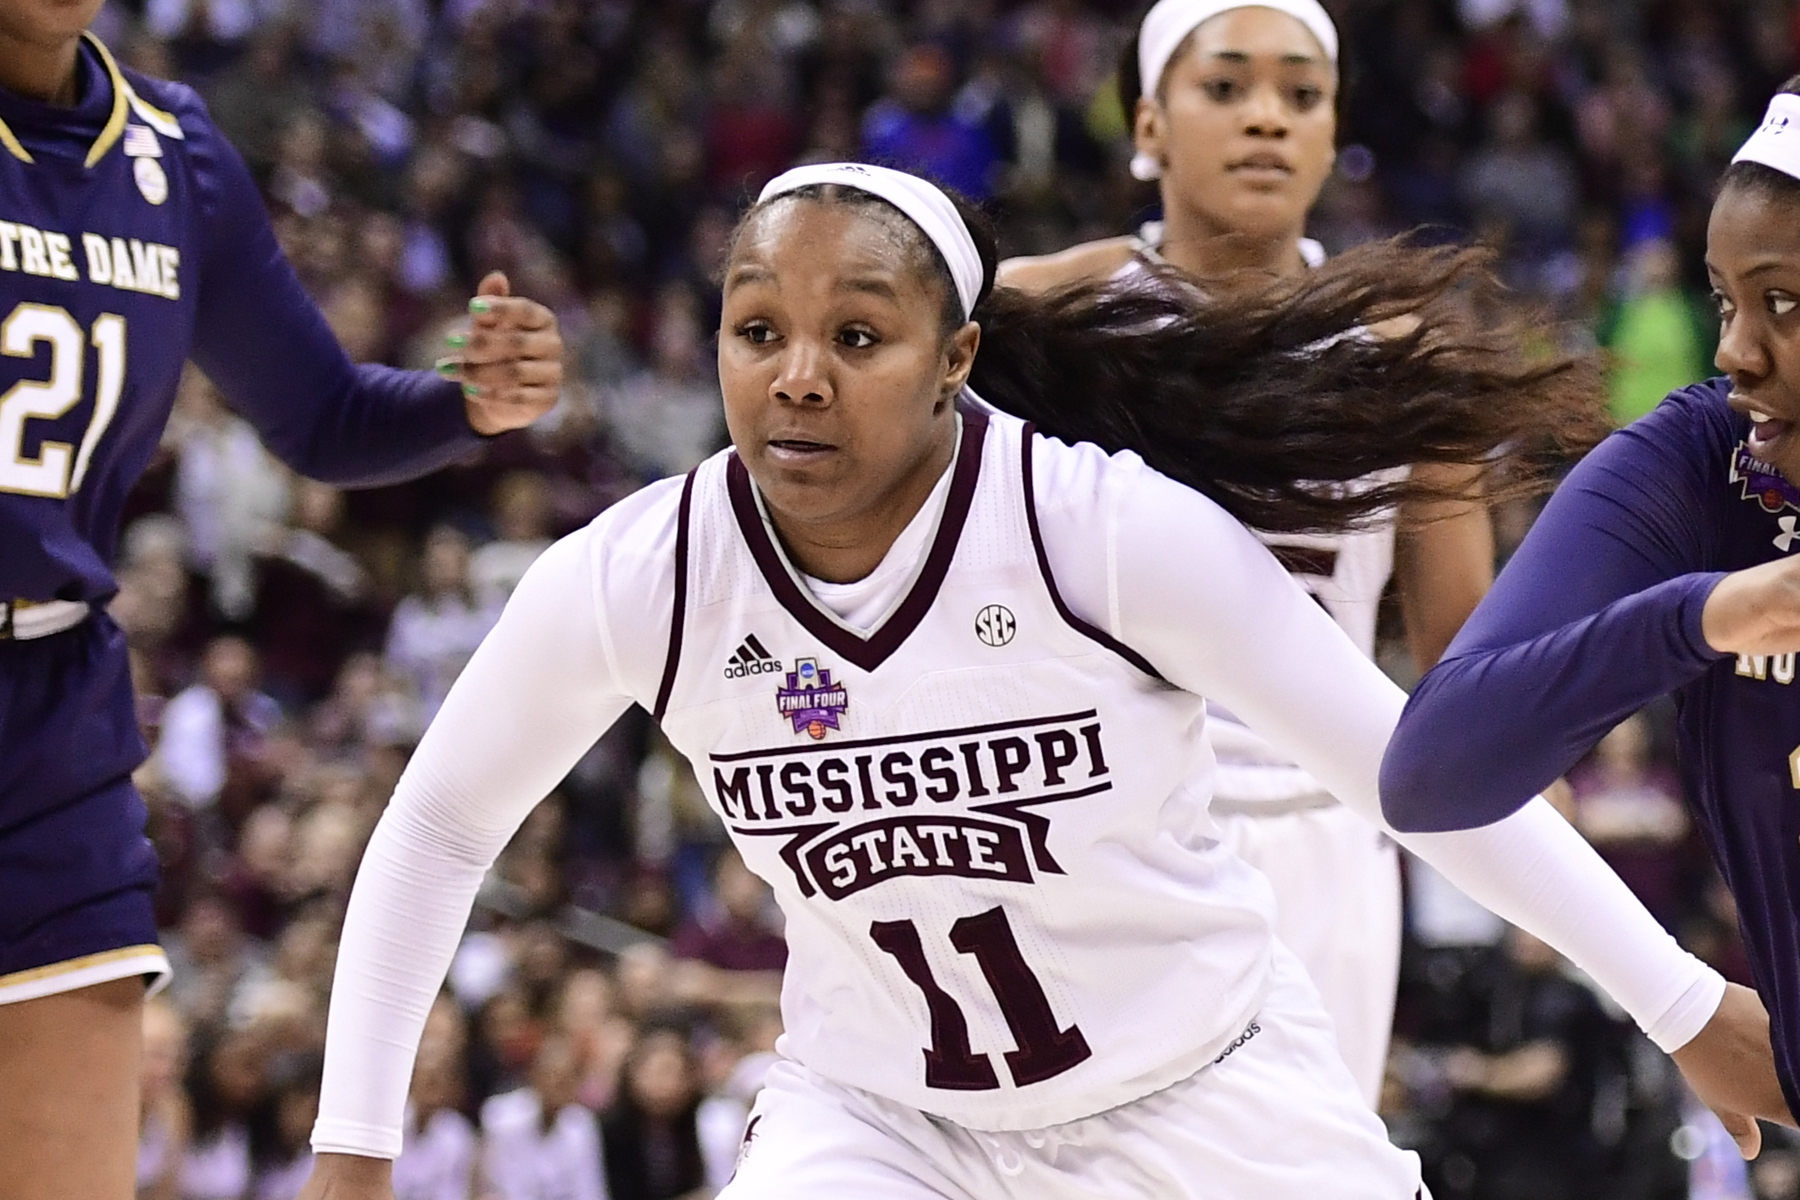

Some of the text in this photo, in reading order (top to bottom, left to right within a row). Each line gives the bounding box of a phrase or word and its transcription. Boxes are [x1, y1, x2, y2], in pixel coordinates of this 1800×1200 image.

[82, 231, 180, 300] DAME
[0, 301, 127, 499] 21
[976, 606, 1015, 645] SEC
[723, 660, 783, 679] adidas
[779, 691, 846, 711] FINAL FOUR
[713, 723, 1110, 820] MISSISSIPPI
[824, 825, 1008, 888] STATE
[869, 904, 1093, 1092] 11
